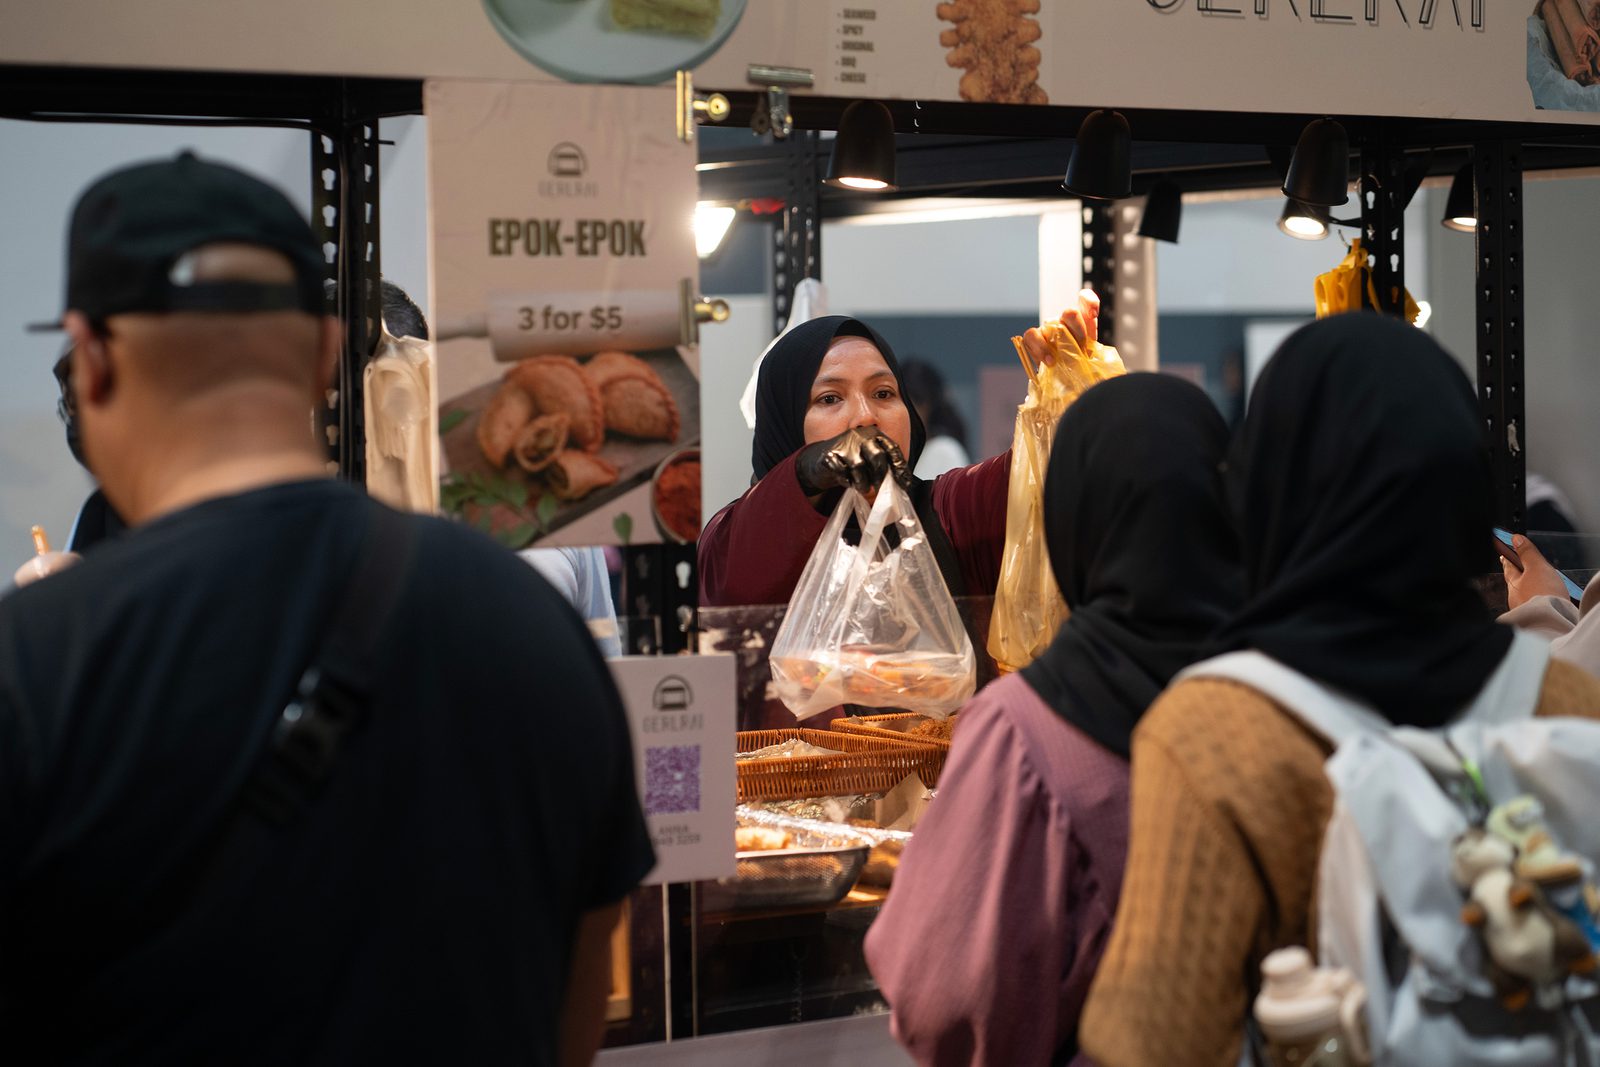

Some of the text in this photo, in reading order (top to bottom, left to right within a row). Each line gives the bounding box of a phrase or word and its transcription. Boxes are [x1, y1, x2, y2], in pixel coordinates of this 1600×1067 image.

[489, 217, 648, 258] EPOK-EPOK
[517, 304, 623, 331] 3 for $5
